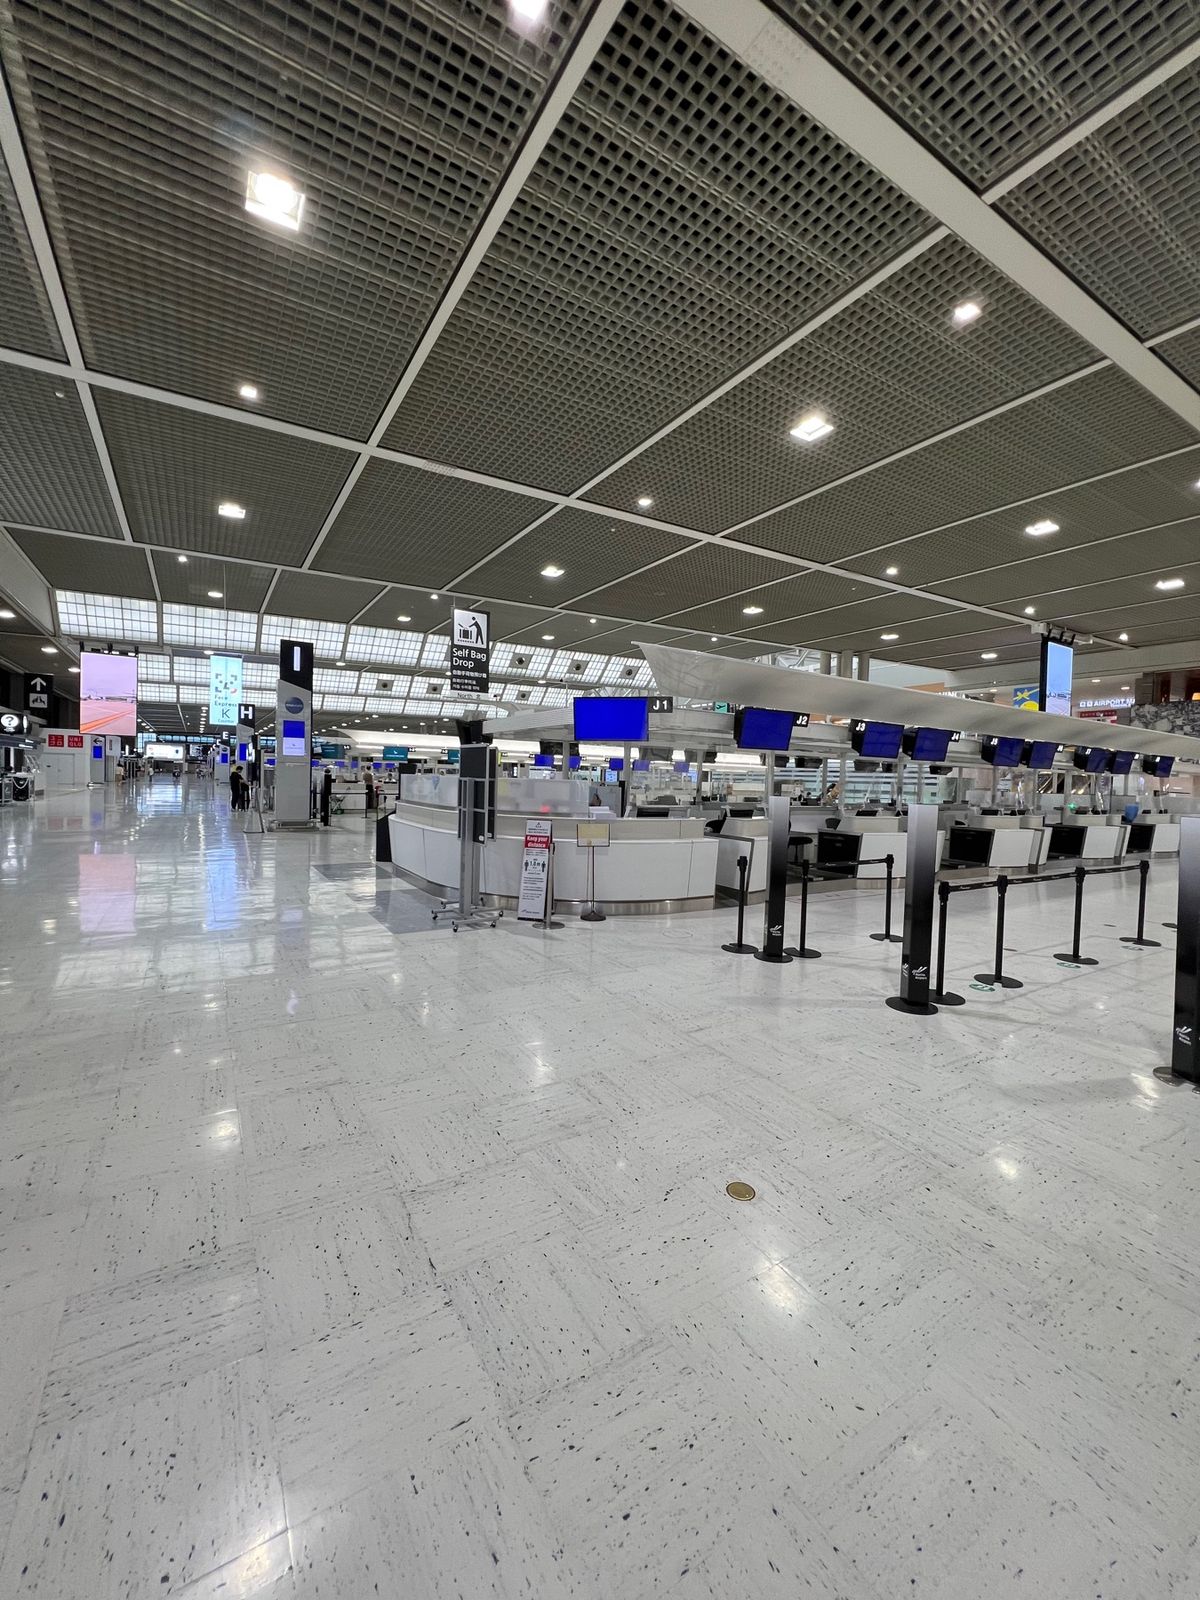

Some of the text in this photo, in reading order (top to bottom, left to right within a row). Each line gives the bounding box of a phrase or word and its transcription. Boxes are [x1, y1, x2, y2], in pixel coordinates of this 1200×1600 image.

[452, 647, 487, 661] Self Bag
[452, 657, 474, 668] Drop
[1094, 698, 1125, 707] AIRPORT
[221, 708, 231, 718] K
[240, 705, 253, 719] H
[796, 715, 808, 725] J2
[855, 721, 866, 731] J3
[951, 732, 960, 741] J4
